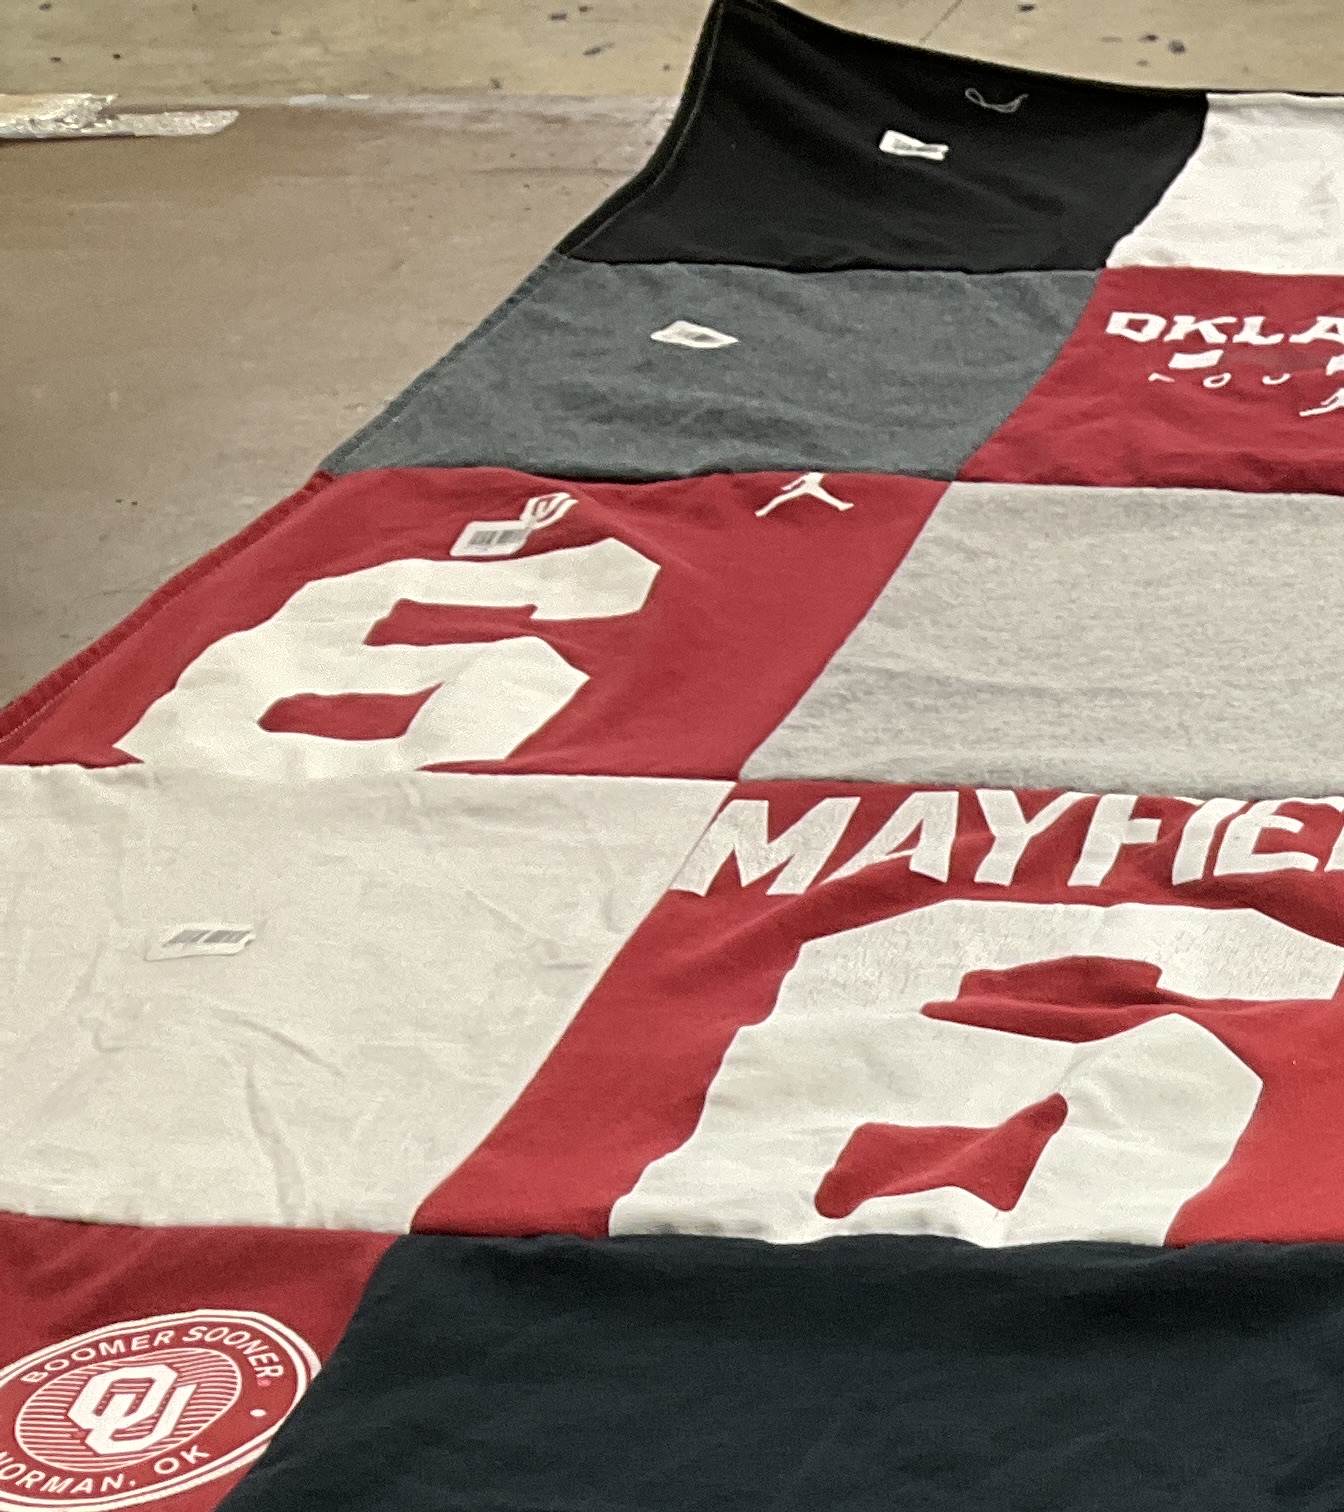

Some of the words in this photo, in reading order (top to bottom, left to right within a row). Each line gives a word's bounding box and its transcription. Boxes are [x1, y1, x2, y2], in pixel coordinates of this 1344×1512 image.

[111, 537, 661, 772] 6
[20, 1329, 176, 1384] BOOMER
[182, 1326, 285, 1380] SOONER
[67, 1364, 198, 1455] OU
[153, 1445, 210, 1475] OK
